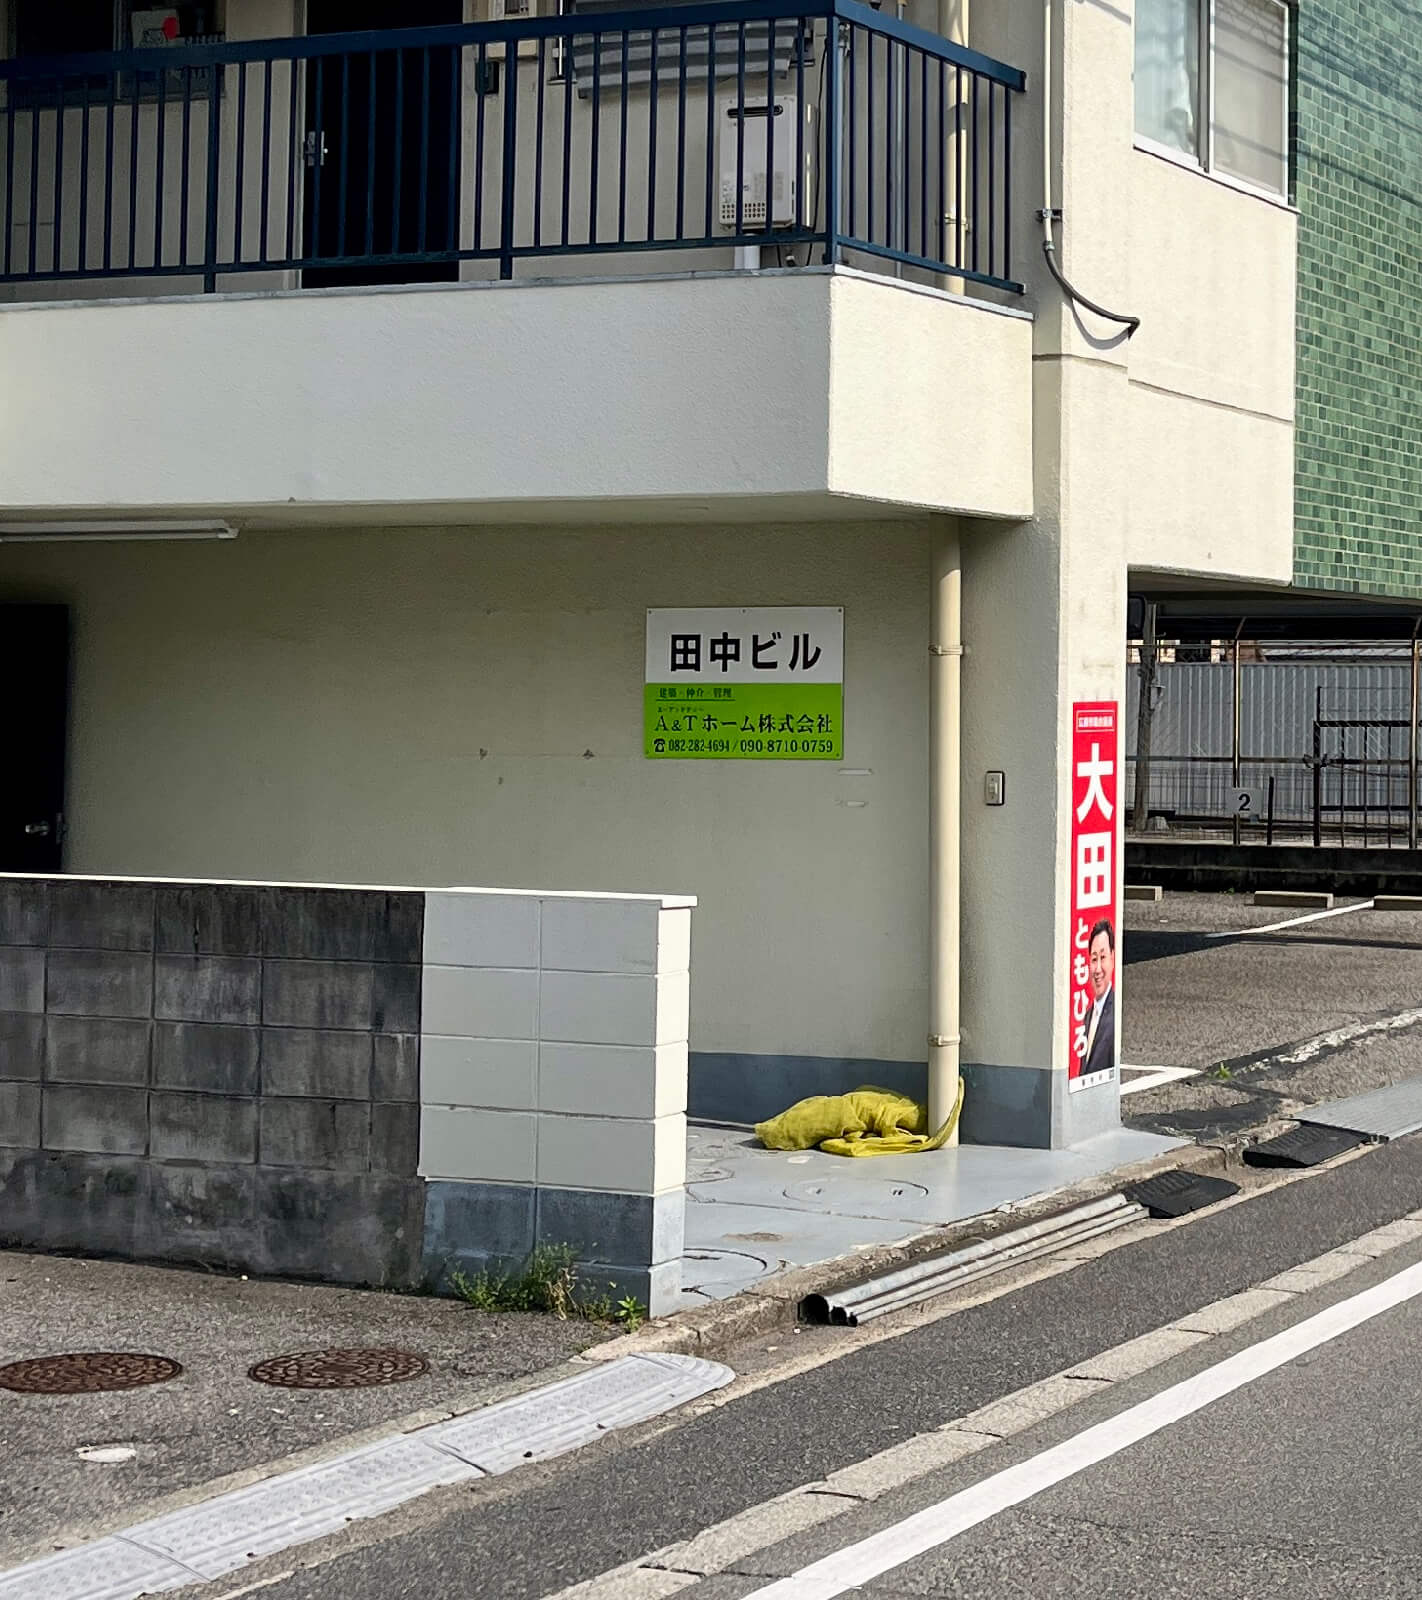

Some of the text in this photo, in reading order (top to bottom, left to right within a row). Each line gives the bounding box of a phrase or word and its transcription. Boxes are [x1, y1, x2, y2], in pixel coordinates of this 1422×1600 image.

[670, 631, 822, 673] 田中ビル
[655, 713, 833, 734] A&Tホーム株式会社
[1239, 794, 1250, 811] 2
[1075, 742, 1114, 910] 大田
[1073, 917, 1089, 1058] ともひろ
